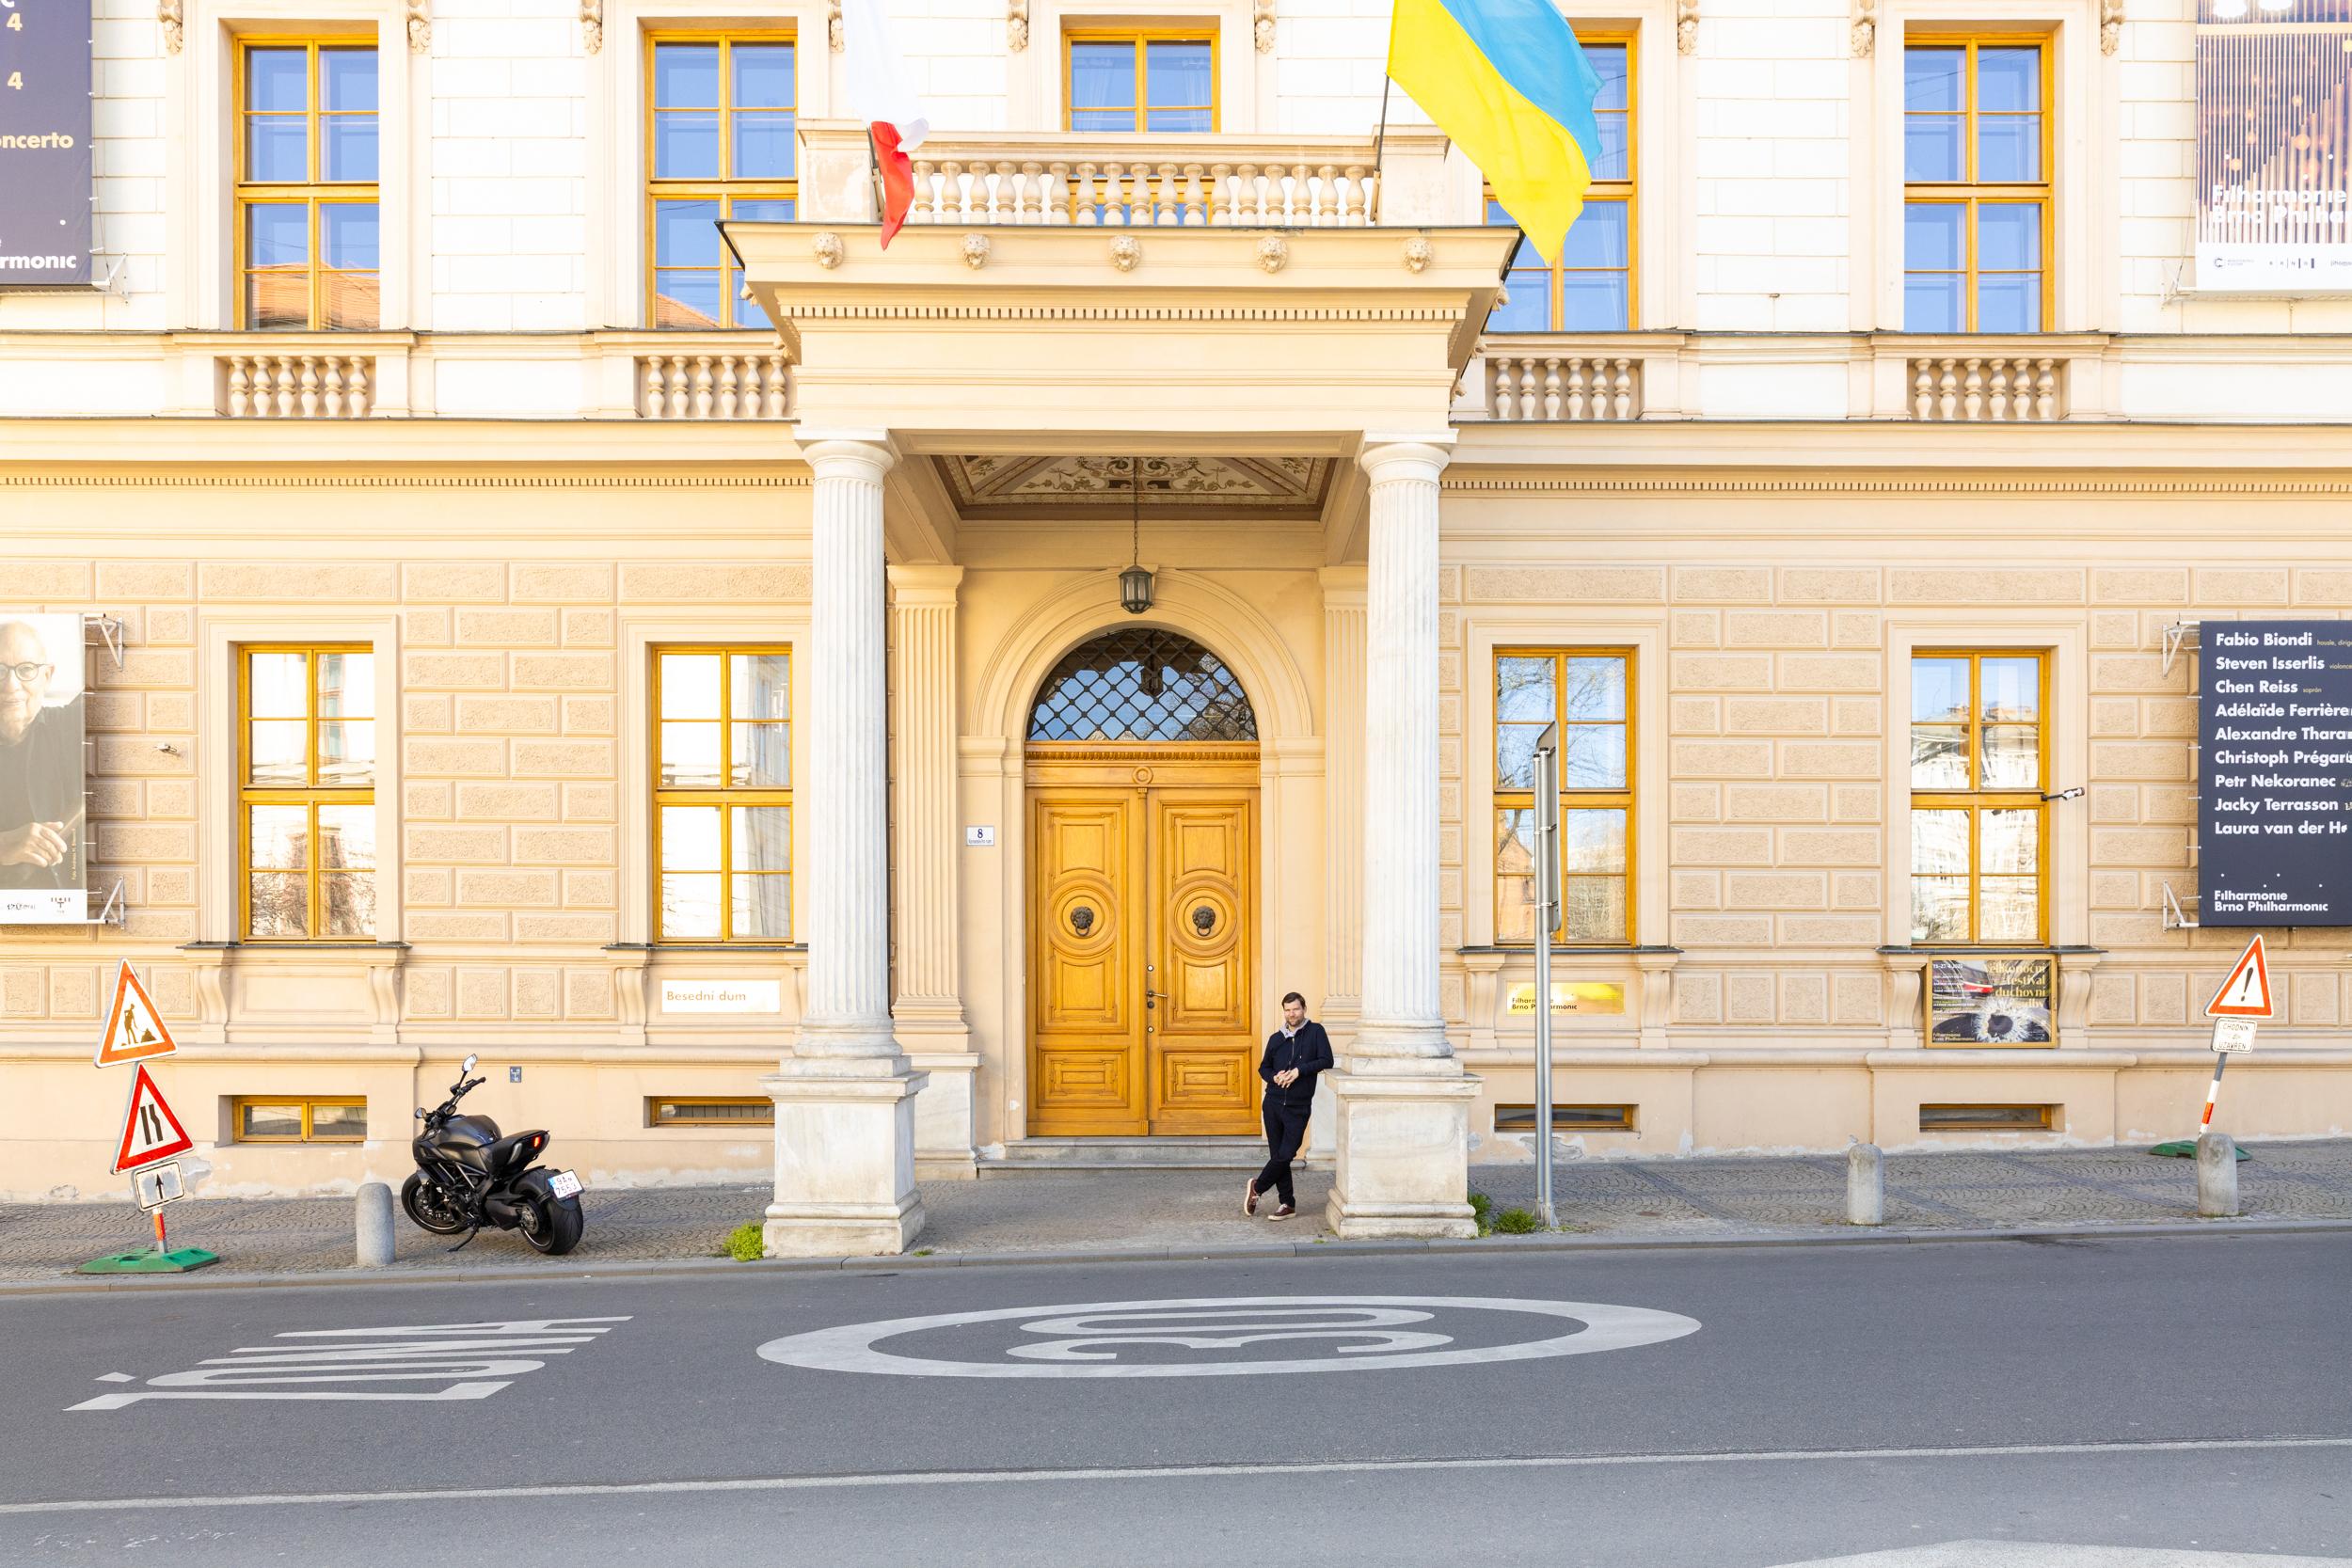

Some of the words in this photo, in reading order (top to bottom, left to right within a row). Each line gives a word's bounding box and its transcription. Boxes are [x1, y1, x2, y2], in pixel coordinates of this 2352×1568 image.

[7, 13, 23, 31] 4
[8, 72, 24, 90] 4
[0, 132, 74, 149] ncerto
[2216, 632, 2259, 646] Fabio
[2264, 632, 2312, 646] Biondi
[2216, 657, 2267, 670] Steven
[2272, 656, 2326, 670] Isserlis
[2215, 679, 2254, 693] Chen
[2259, 679, 2298, 693] Reiss
[2215, 703, 2285, 717] Adélaïde
[2215, 726, 2297, 740] Alexandre
[2215, 750, 2289, 768] Christoph
[2215, 774, 2247, 787] Petr
[2251, 773, 2336, 787] Nekoranec
[2215, 798, 2260, 815] Jacky
[2264, 799, 2339, 811] Terrasson
[977, 828, 984, 839] 8
[2215, 821, 2260, 834] Laura
[2264, 824, 2294, 834] van
[2297, 820, 2325, 834] der
[2214, 902, 2245, 911] Brno
